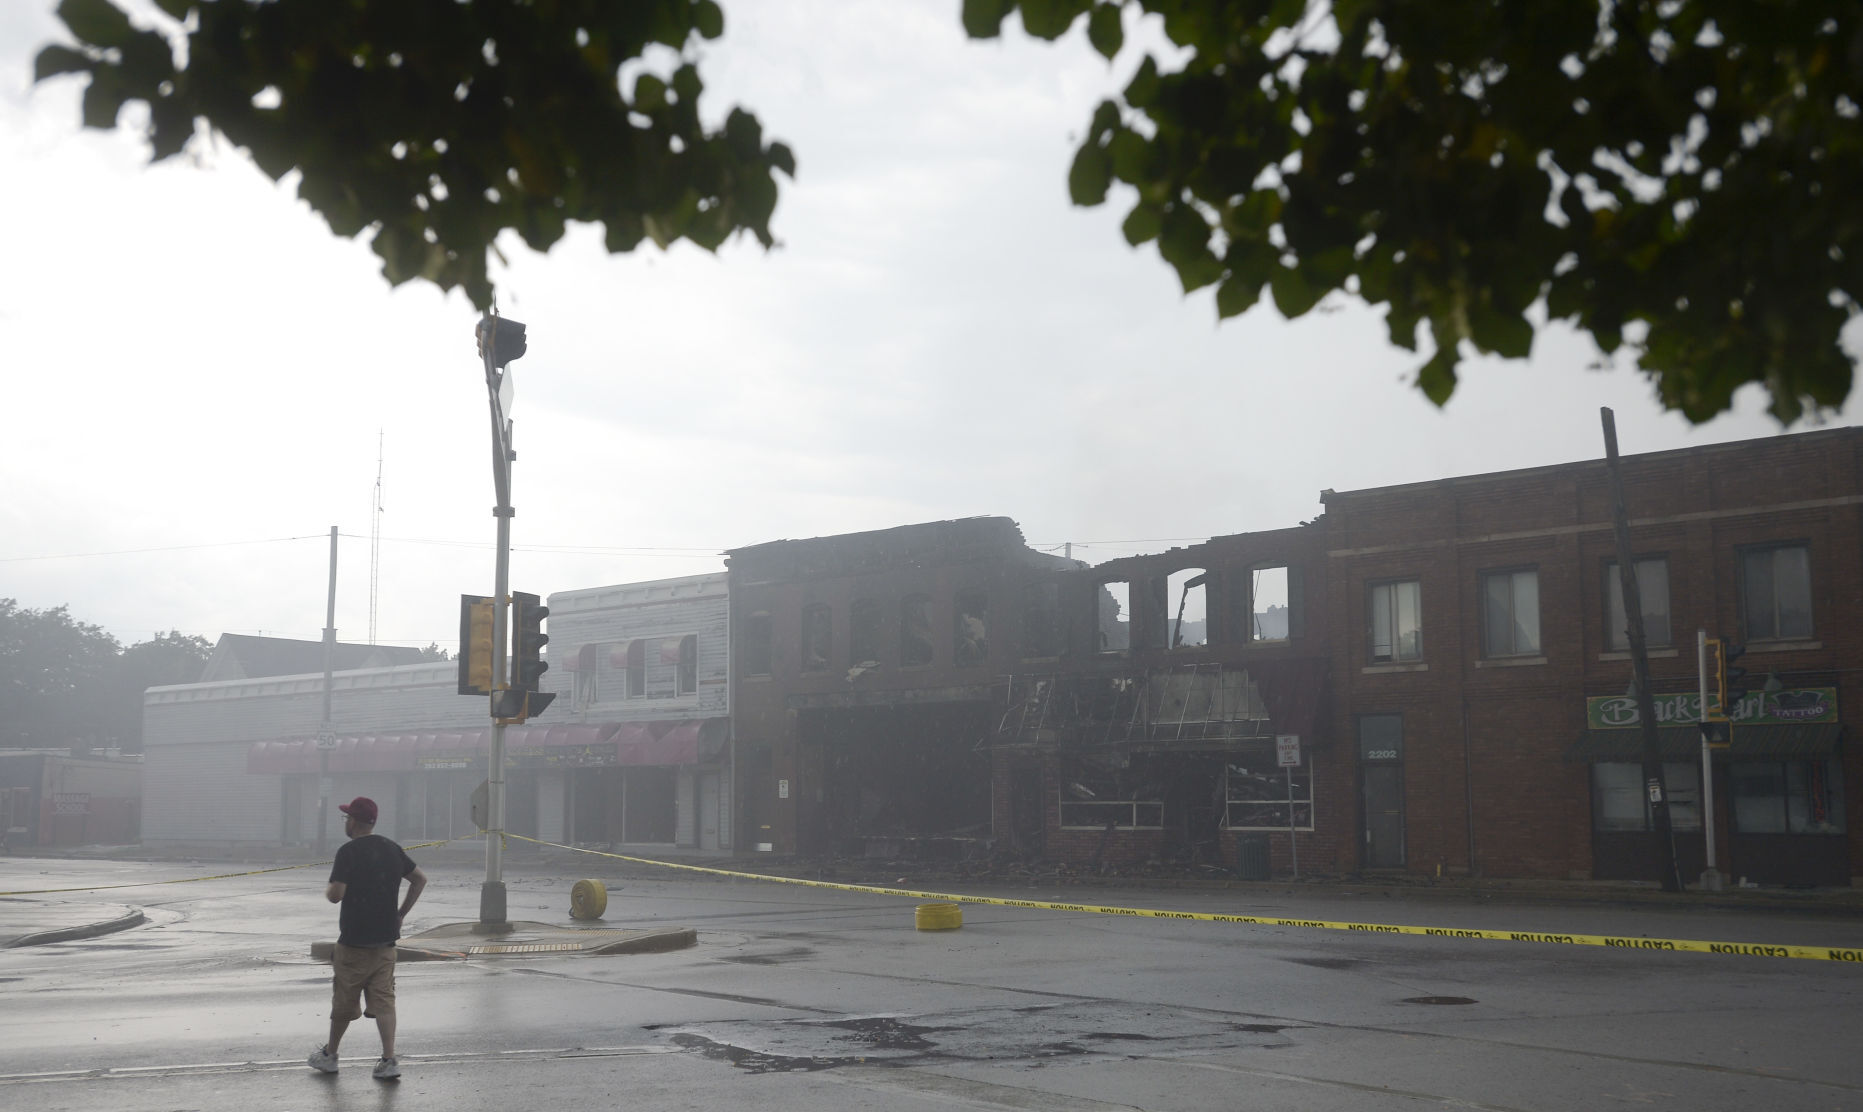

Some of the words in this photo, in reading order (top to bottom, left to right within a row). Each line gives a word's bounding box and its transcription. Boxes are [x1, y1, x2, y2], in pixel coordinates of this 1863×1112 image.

[1600, 696, 1696, 725] Back
[1774, 706, 1823, 718] TATTOO
[319, 736, 335, 746] 50
[1368, 750, 1397, 760] 2202
[1510, 933, 1574, 944] CAUTION
[1604, 938, 1675, 950] CAUTION
[1710, 943, 1789, 957] CAUTION
